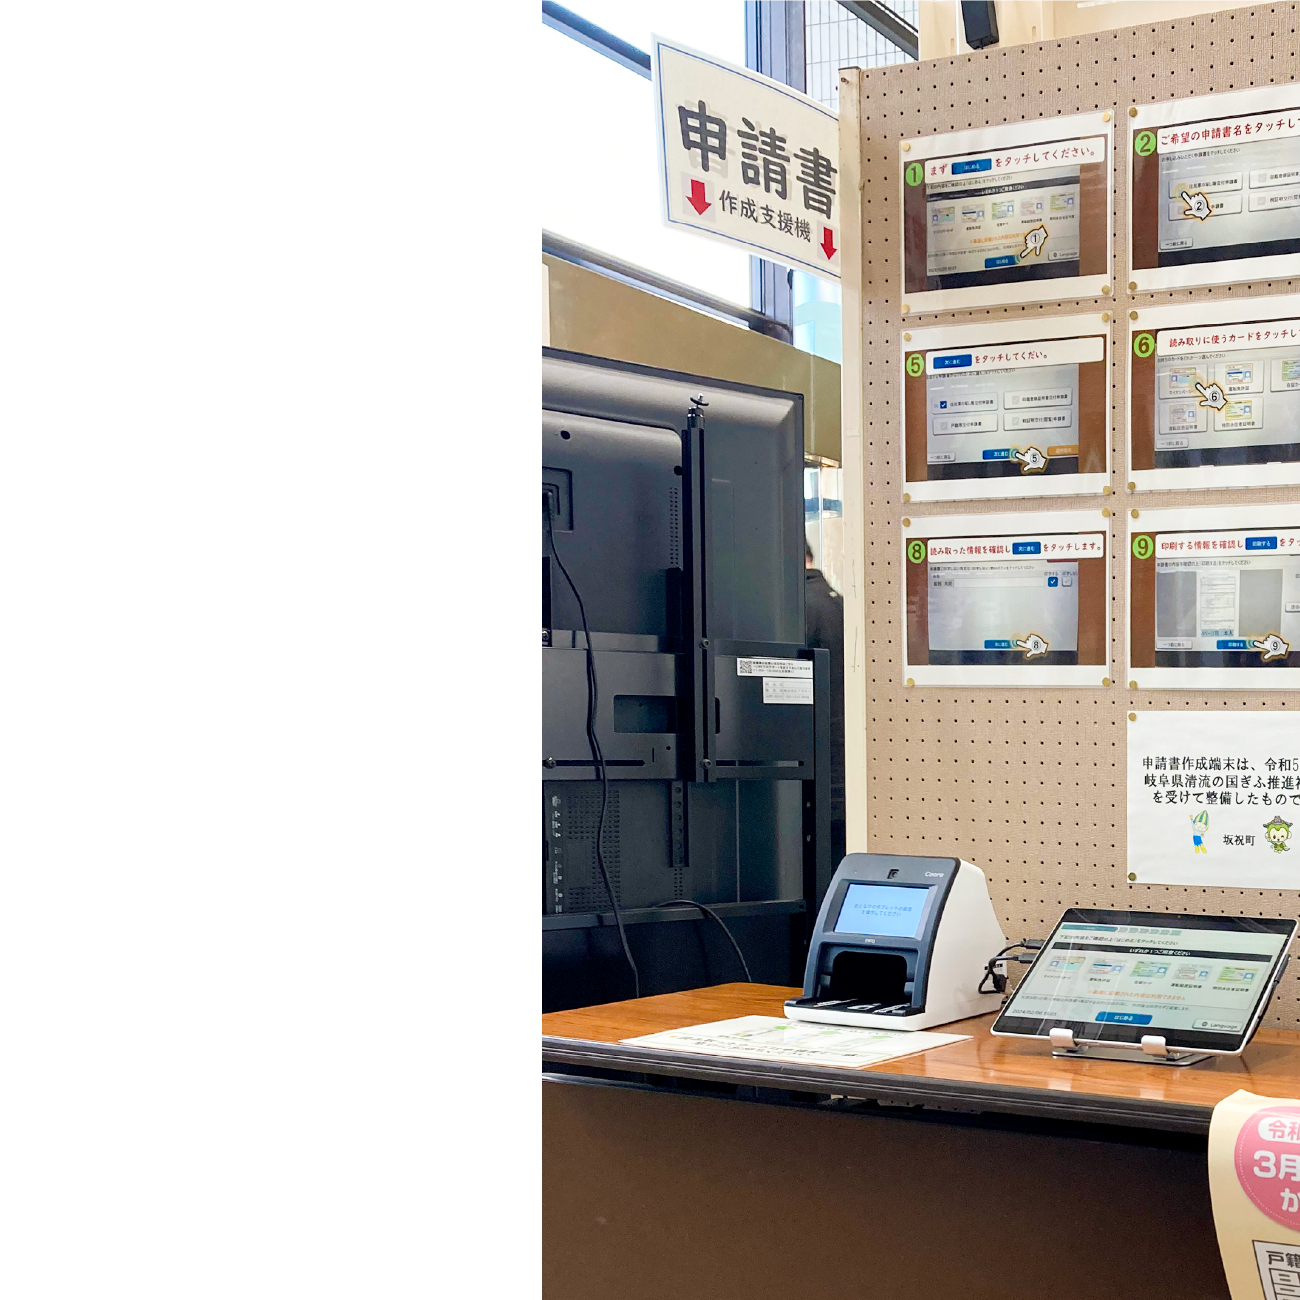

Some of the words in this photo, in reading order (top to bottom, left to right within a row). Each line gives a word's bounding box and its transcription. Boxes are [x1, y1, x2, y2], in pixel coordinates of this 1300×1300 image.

[678, 100, 838, 220] 申請書
[930, 163, 948, 176] まず
[995, 147, 1095, 168] をタッチしてください。
[719, 190, 811, 243] 作成支援機
[975, 351, 1048, 364] をタッチしてくだい。
[930, 545, 1011, 556] 読み取った情報を確認し
[1043, 542, 1101, 552] をタッチします。
[1161, 541, 1243, 551] 印刷する情報を確認し
[1223, 834, 1256, 846] 坂祝町
[1210, 1022, 1239, 1030] Language
